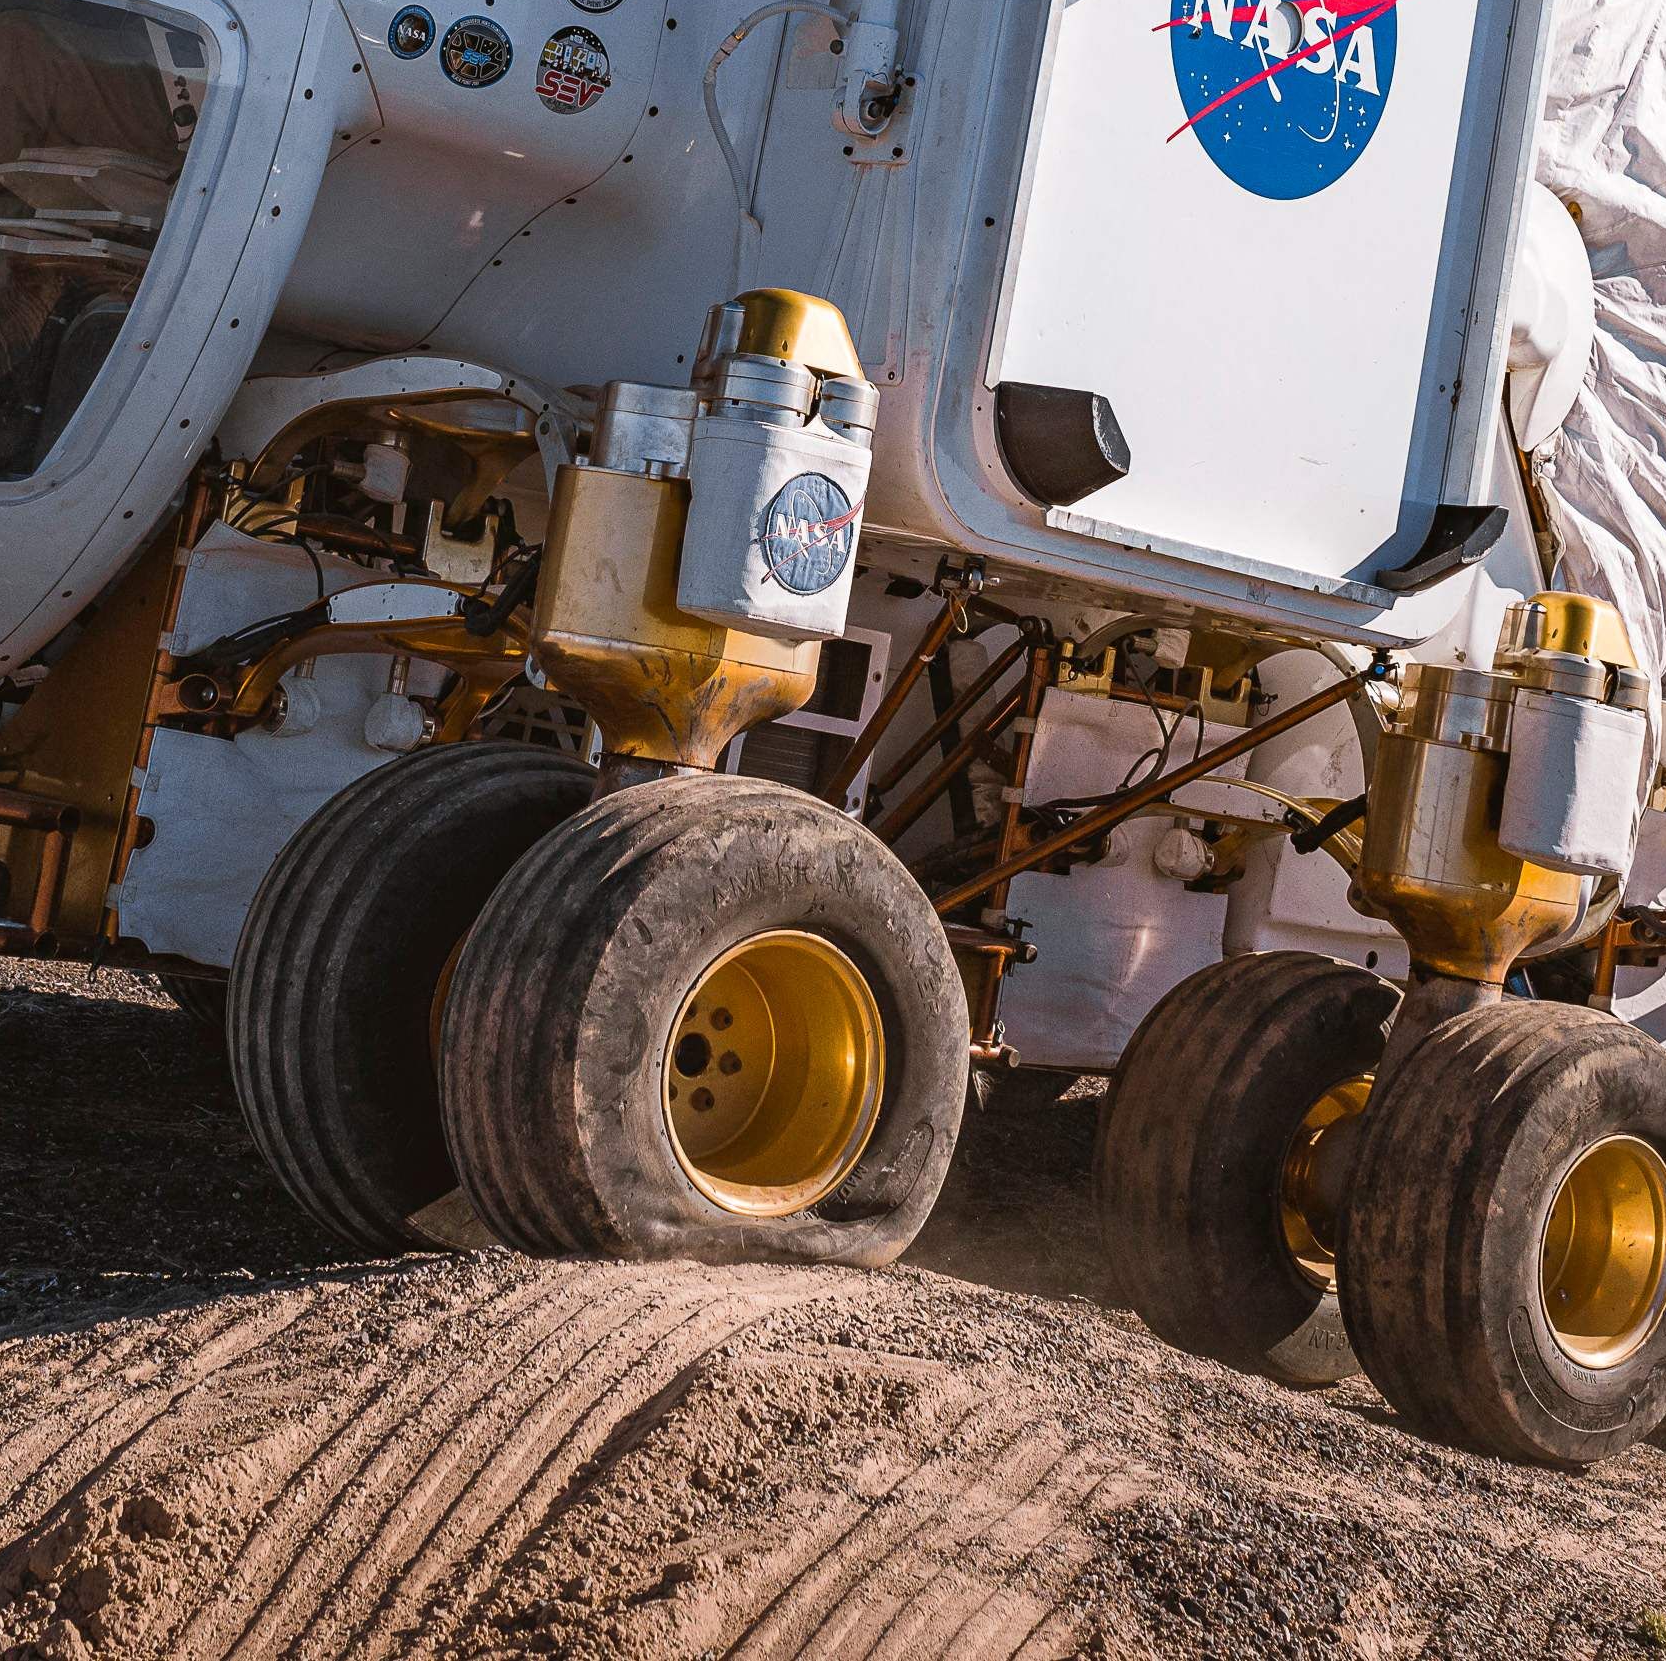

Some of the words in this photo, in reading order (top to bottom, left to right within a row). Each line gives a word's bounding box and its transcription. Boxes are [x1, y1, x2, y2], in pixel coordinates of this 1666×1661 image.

[397, 24, 426, 41] NASA
[534, 69, 606, 107] SEV
[776, 513, 846, 553] NASA
[1571, 1367, 1598, 1386] MADE
